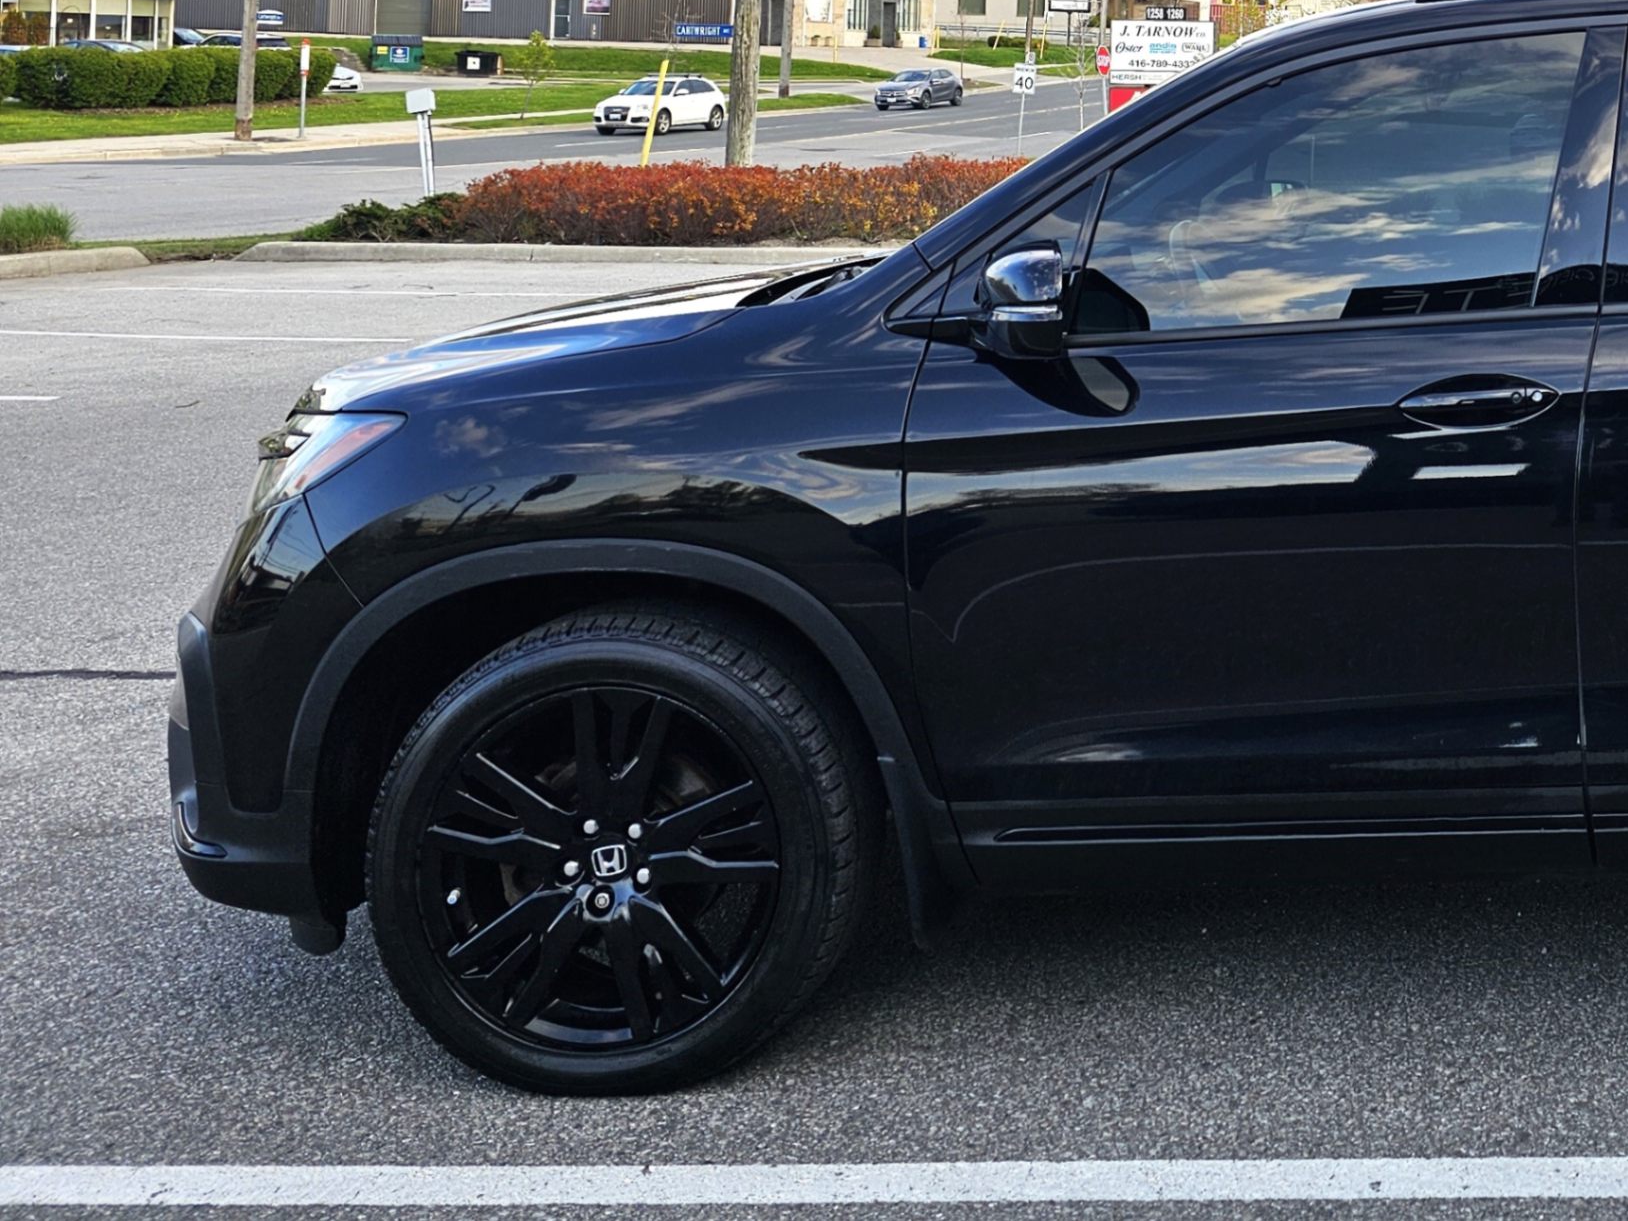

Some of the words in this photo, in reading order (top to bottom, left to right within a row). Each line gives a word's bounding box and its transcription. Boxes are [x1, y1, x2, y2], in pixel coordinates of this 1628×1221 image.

[676, 25, 720, 36] CARTWRIGHT
[1135, 25, 1198, 37] TARNOW
[1115, 42, 1144, 54] Oster
[1015, 77, 1034, 90] 40
